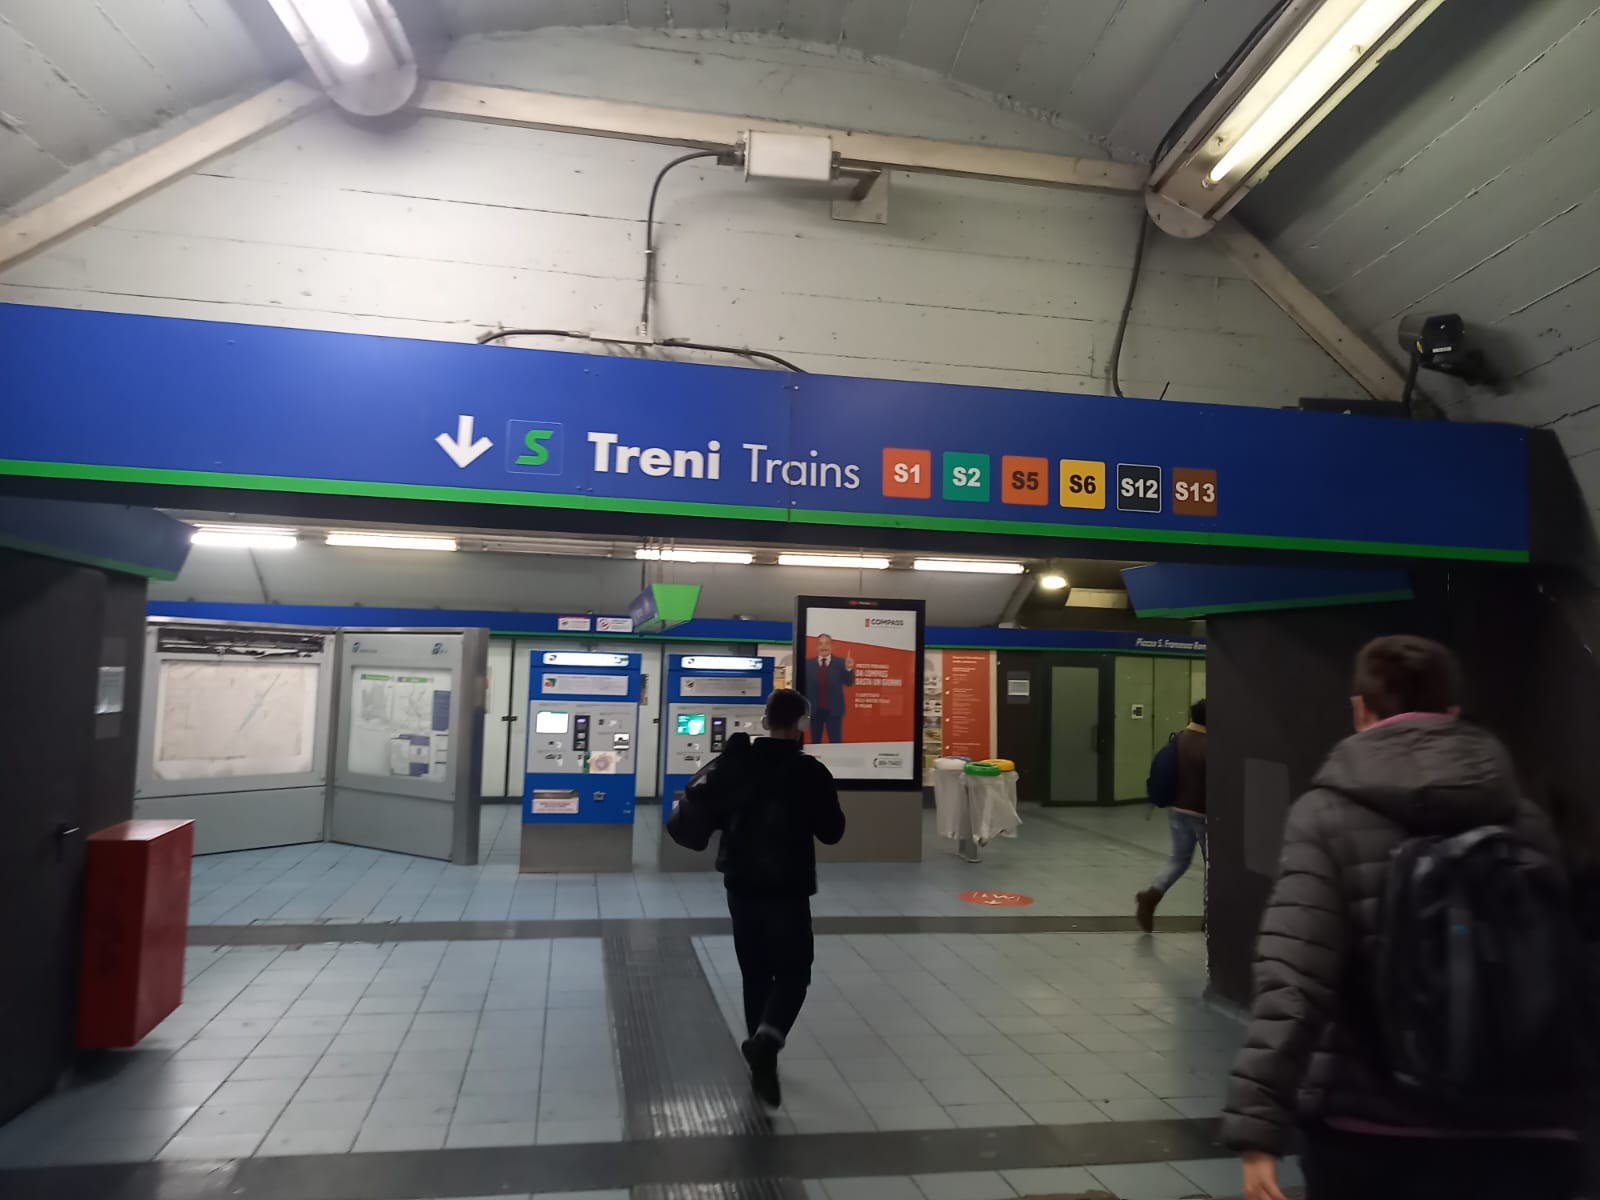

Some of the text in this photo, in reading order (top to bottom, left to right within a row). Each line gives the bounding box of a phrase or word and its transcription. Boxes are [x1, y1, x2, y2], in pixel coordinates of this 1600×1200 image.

[587, 431, 720, 480] Treni
[742, 443, 861, 489] Trains
[893, 463, 921, 484] S1
[952, 466, 981, 487] S2
[1011, 470, 1039, 491] S5
[1069, 474, 1096, 495] S6
[1120, 478, 1159, 500] S12
[1175, 481, 1215, 503] S13
[871, 618, 904, 626] COMPASS
